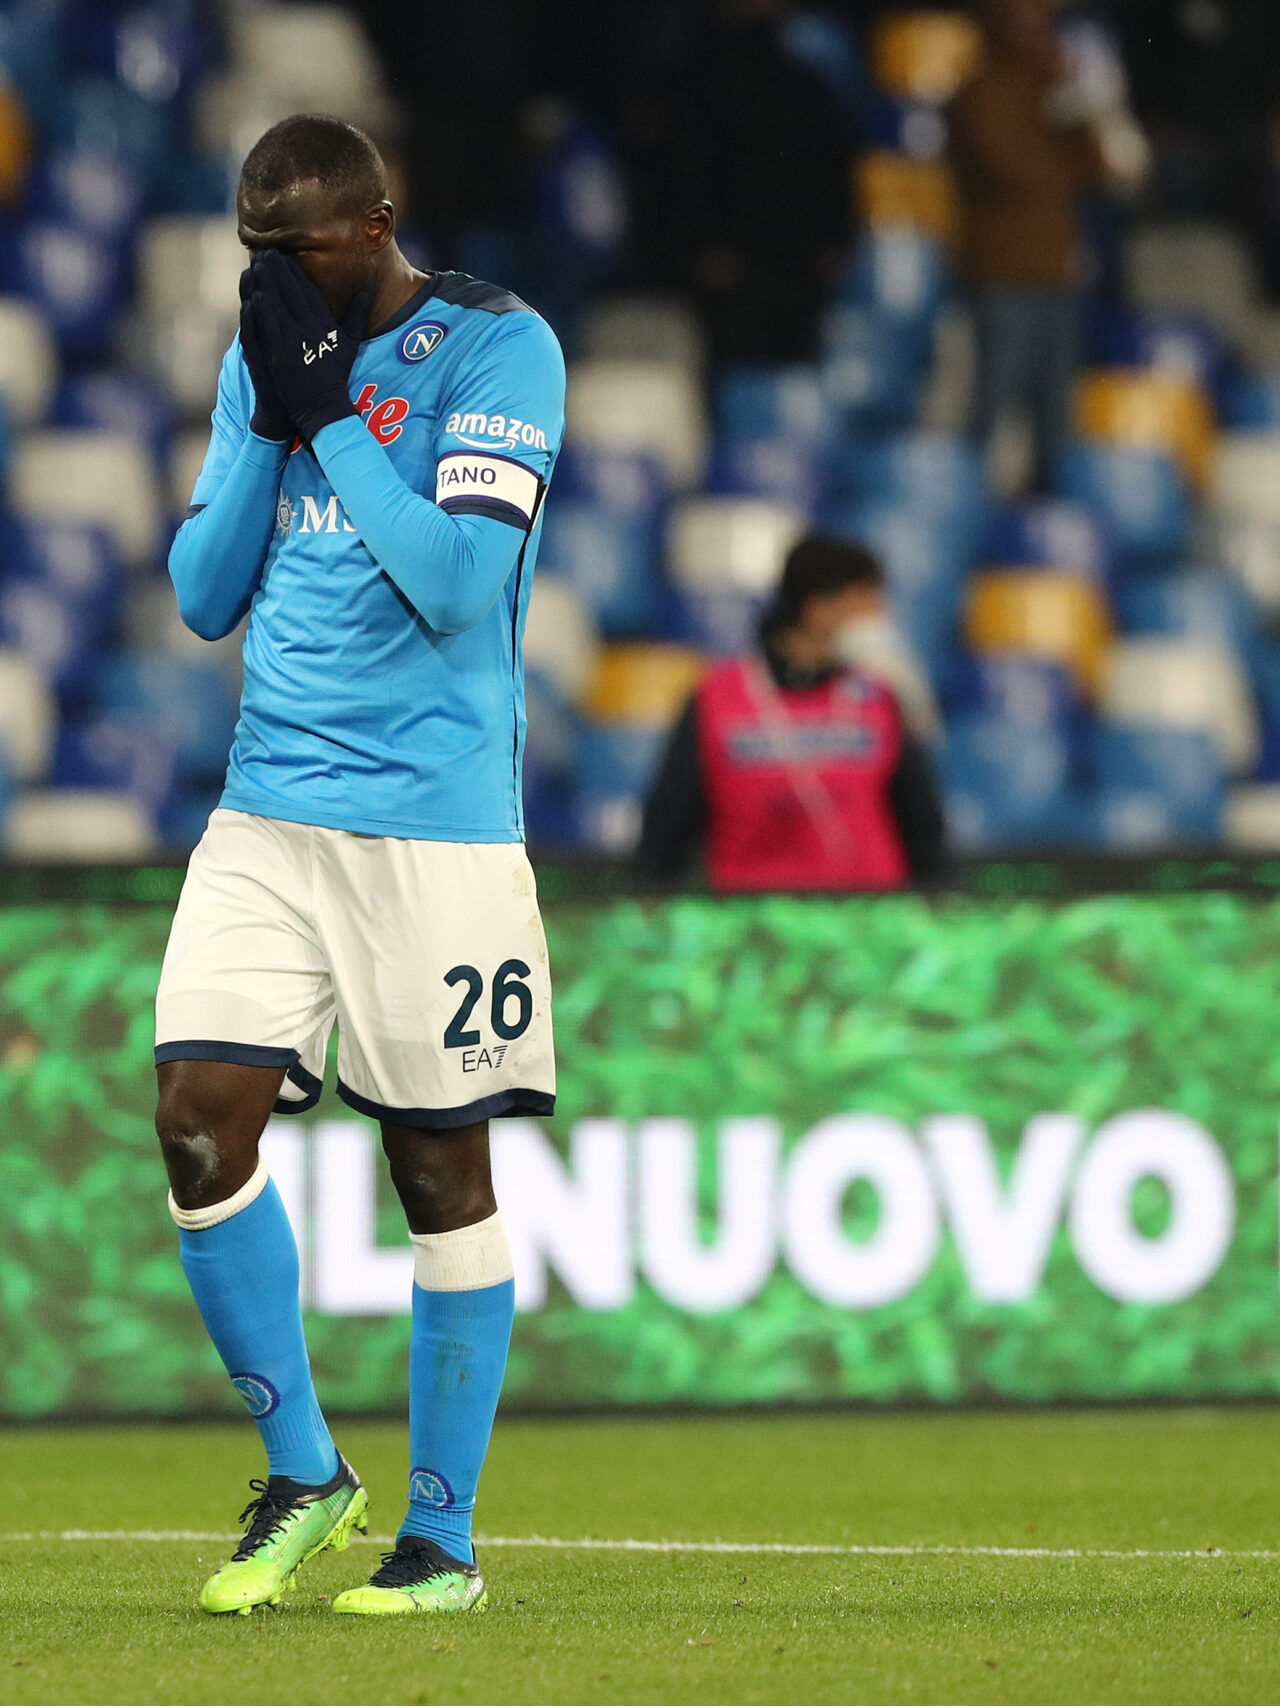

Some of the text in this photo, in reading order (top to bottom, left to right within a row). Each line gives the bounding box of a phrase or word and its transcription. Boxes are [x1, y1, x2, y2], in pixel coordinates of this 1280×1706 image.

[445, 412, 548, 450] amazon
[443, 958, 533, 1049] 26
[462, 1044, 509, 1073] EA7
[486, 1108, 1237, 1315] NUOVO
